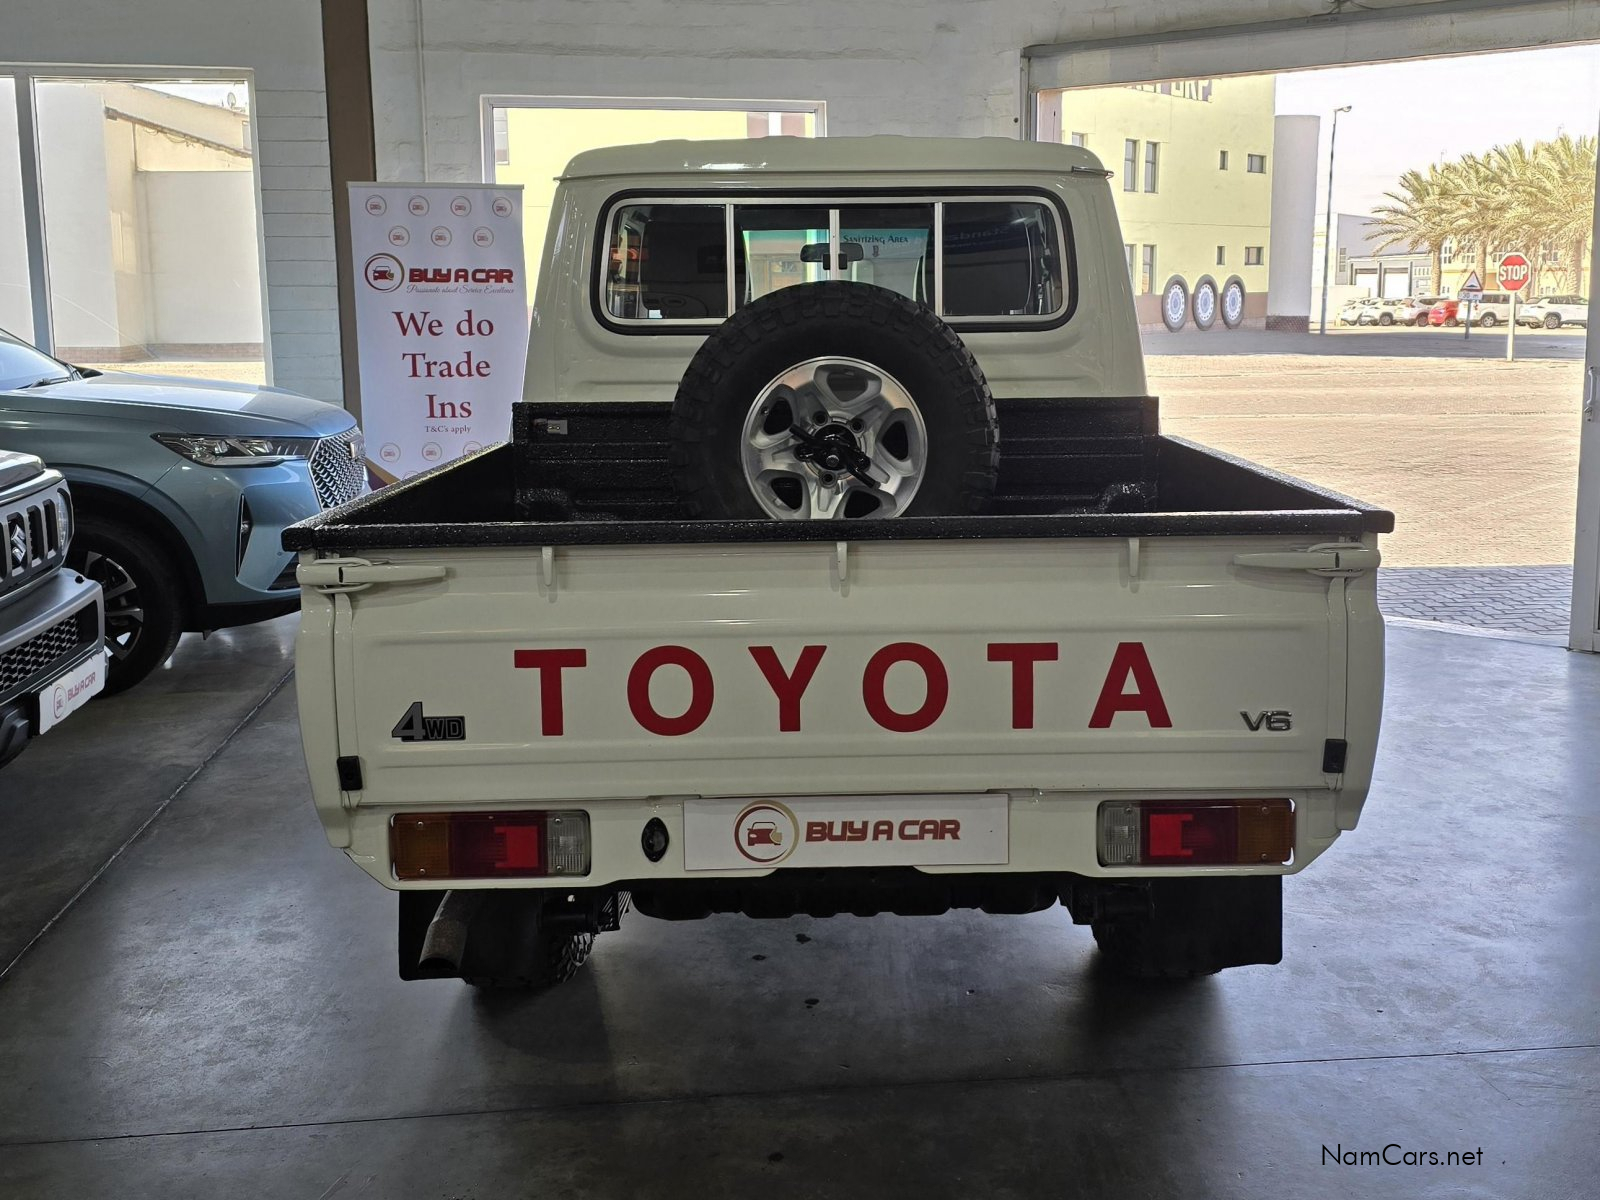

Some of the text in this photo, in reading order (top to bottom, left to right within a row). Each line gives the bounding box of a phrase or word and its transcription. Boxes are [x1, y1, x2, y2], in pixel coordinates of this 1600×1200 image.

[409, 268, 514, 284] BUY A CAR
[1500, 265, 1528, 280] STOP
[392, 309, 494, 337] We do
[402, 351, 491, 378] Trade
[425, 394, 472, 419] Ins
[451, 425, 471, 435] apply
[67, 683, 80, 702] BUY
[84, 672, 96, 688] CAR
[514, 642, 1173, 737] TOYOTA
[391, 701, 467, 742] 4WD
[1240, 711, 1293, 732] V6
[805, 819, 961, 842] BUY A CAR
